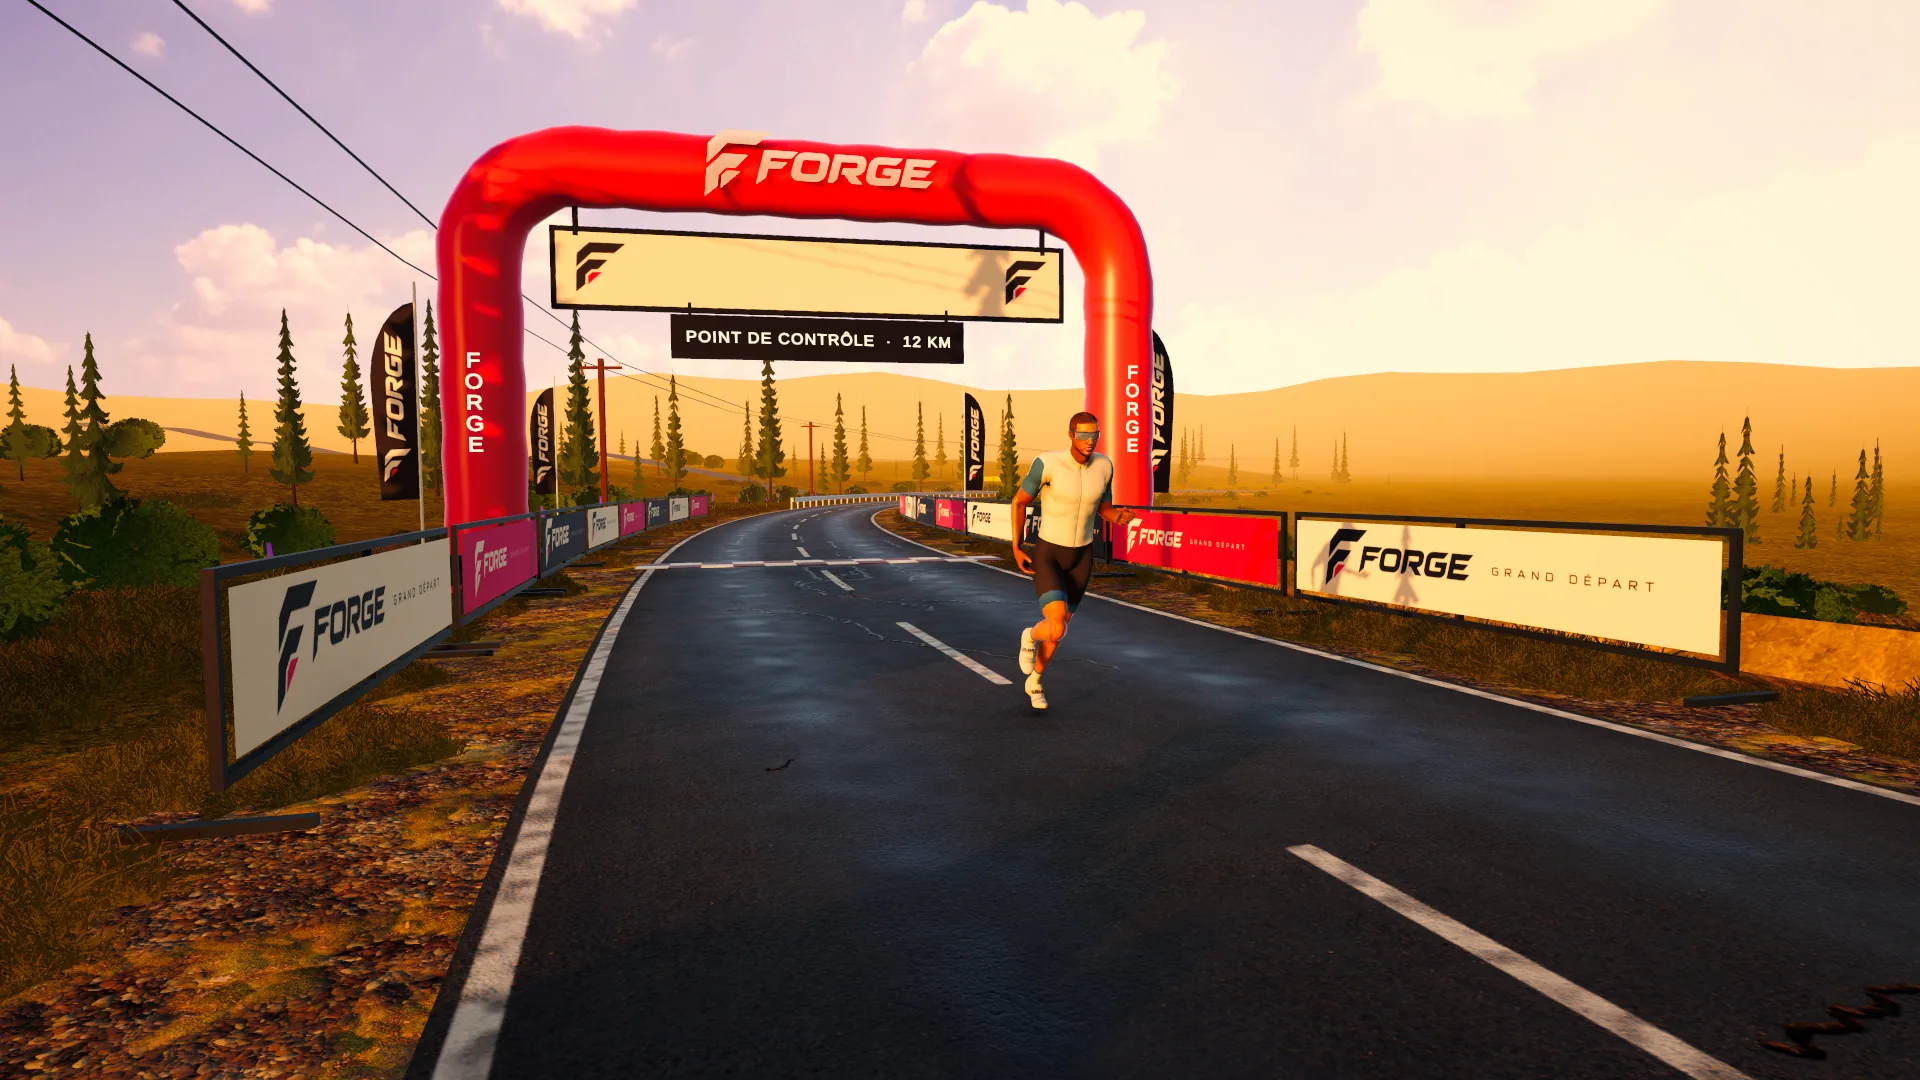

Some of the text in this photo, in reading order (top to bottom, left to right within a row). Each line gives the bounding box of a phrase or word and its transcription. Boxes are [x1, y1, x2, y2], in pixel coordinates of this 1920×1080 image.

[756, 149, 937, 190] FORGE
[685, 330, 742, 344] POINT
[747, 331, 772, 345] DE
[778, 331, 874, 348] CONTRÔLE
[902, 335, 922, 349] 12
[927, 336, 951, 349] KM
[383, 331, 407, 442] FORGE
[464, 351, 485, 453] FORGE
[1125, 365, 1140, 453] FORGE
[1152, 352, 1166, 444] FORGE
[537, 402, 550, 463] FORGE
[970, 406, 981, 463] FORGE
[552, 525, 570, 552] FORGE
[976, 512, 991, 524] FORGE
[1139, 528, 1246, 551] FORGE GRAND DÉPART
[483, 546, 508, 578] FORGE
[1358, 545, 1656, 593] FORGE GRAND DÉPART
[313, 586, 386, 663] FORGE
[393, 587, 416, 606] GRAND
